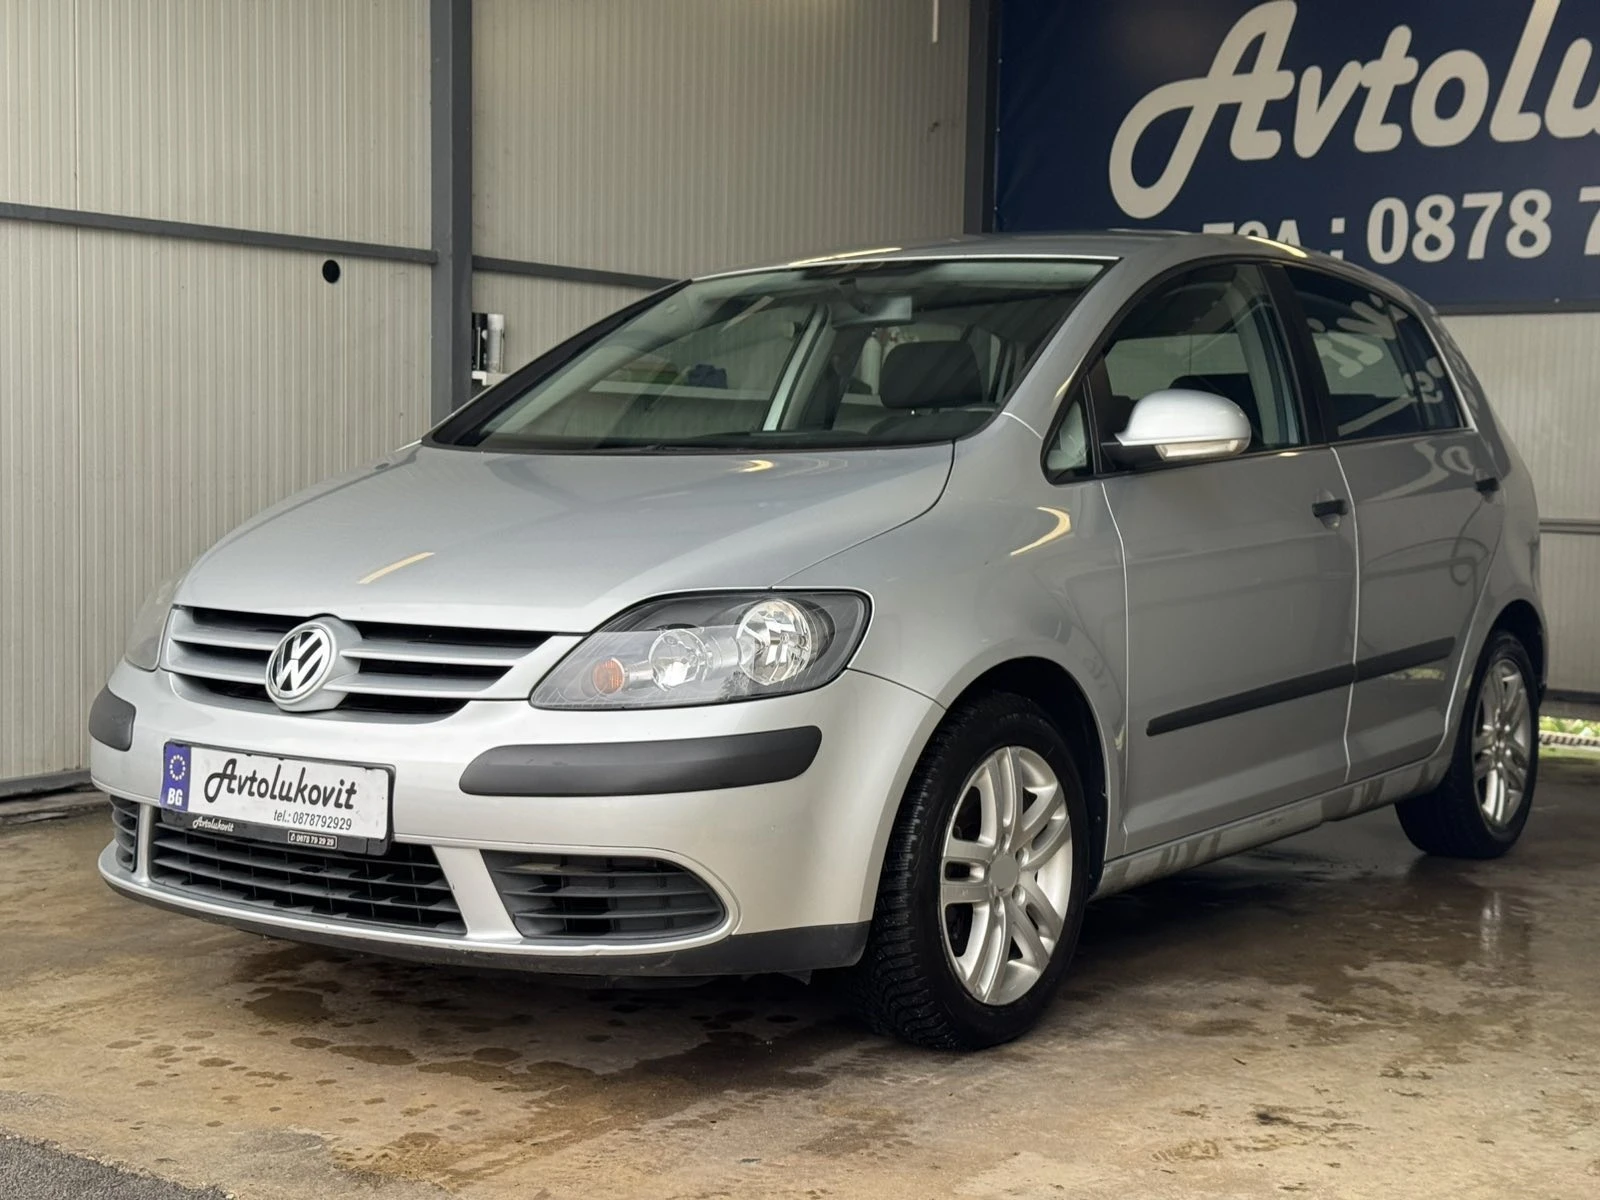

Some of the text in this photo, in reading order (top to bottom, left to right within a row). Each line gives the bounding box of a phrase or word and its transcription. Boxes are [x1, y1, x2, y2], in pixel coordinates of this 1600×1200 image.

[1367, 188, 1553, 265] 0878
[204, 758, 357, 810] Avtolukovit
[167, 787, 183, 806] BG
[192, 815, 234, 832] Avtolukovit
[273, 809, 352, 831] tel.: 0878792929
